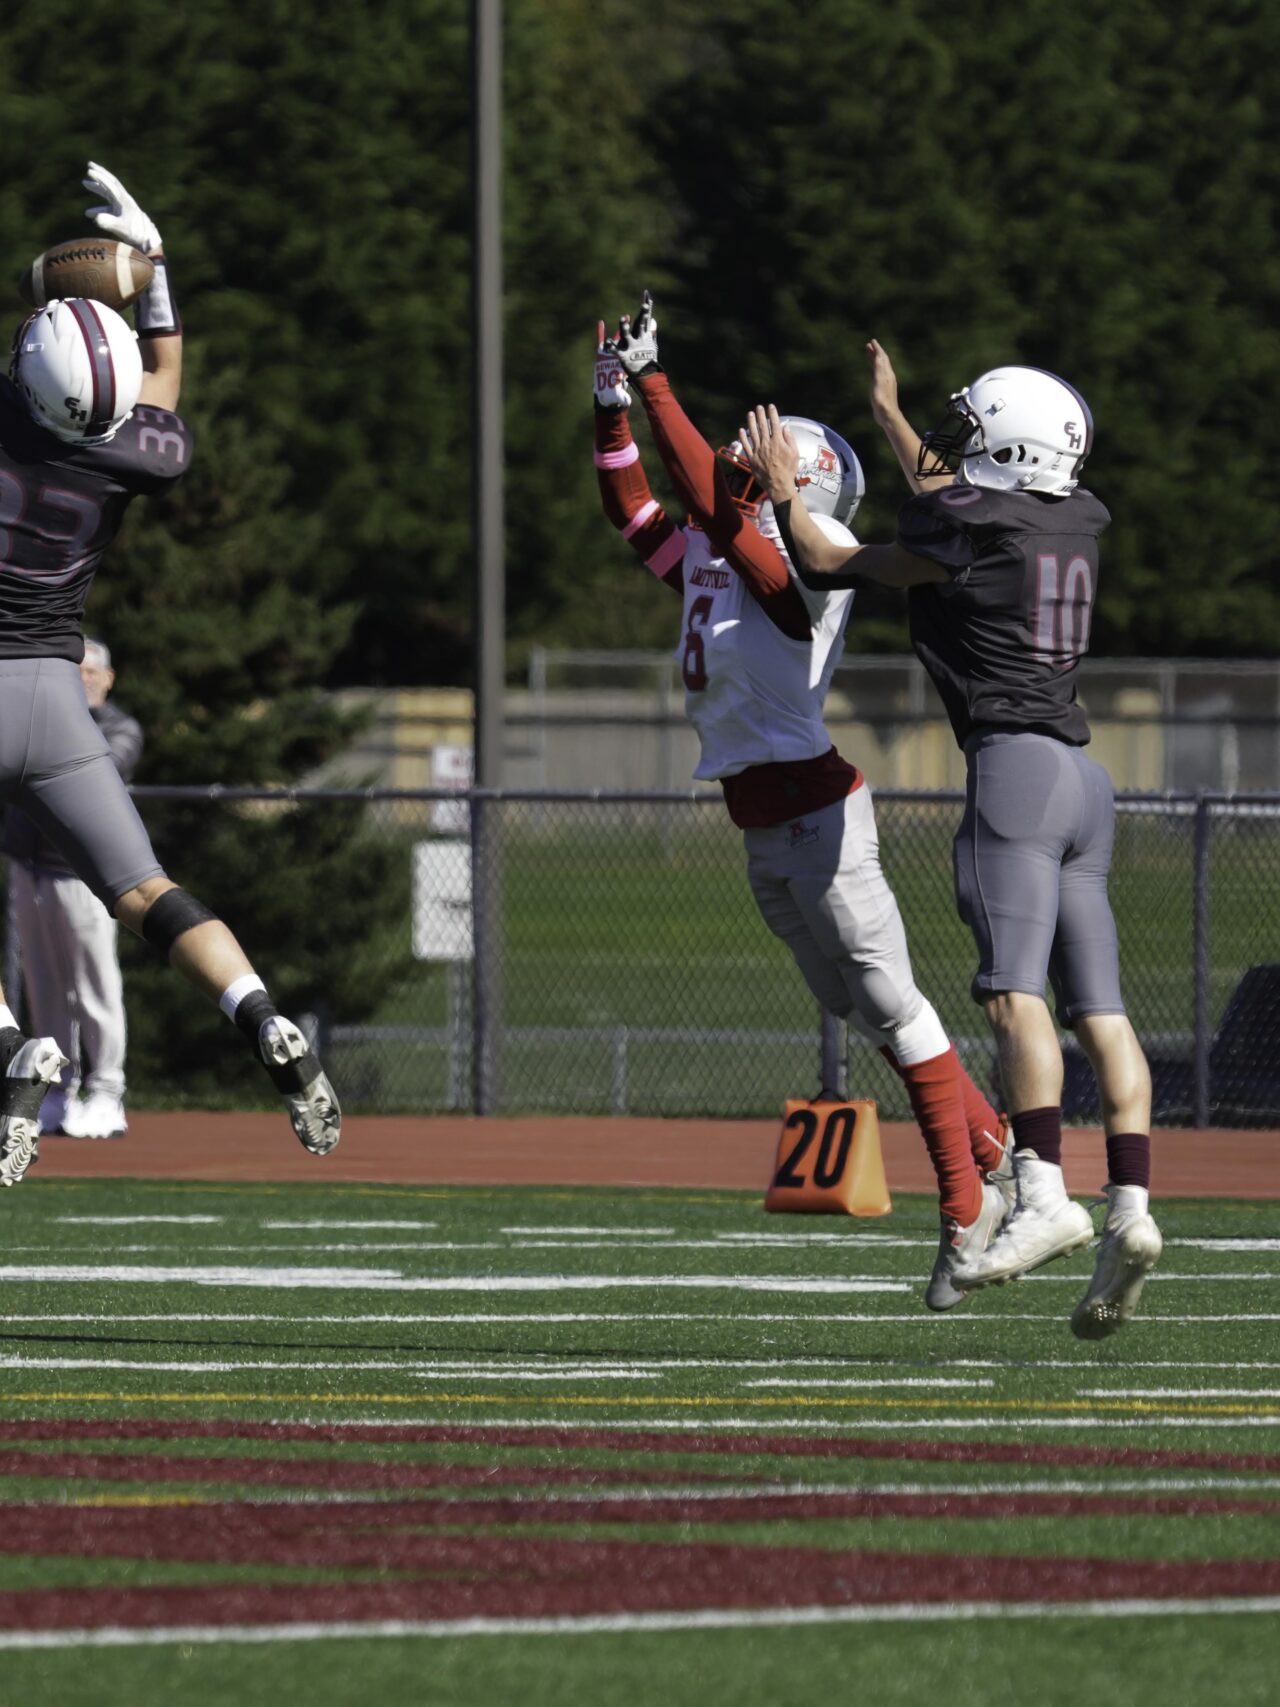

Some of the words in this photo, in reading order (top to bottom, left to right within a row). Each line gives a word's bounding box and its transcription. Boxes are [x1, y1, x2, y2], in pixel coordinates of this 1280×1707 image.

[682, 594, 714, 693] 6
[1031, 553, 1092, 667] 10
[773, 1107, 857, 1189] 20
